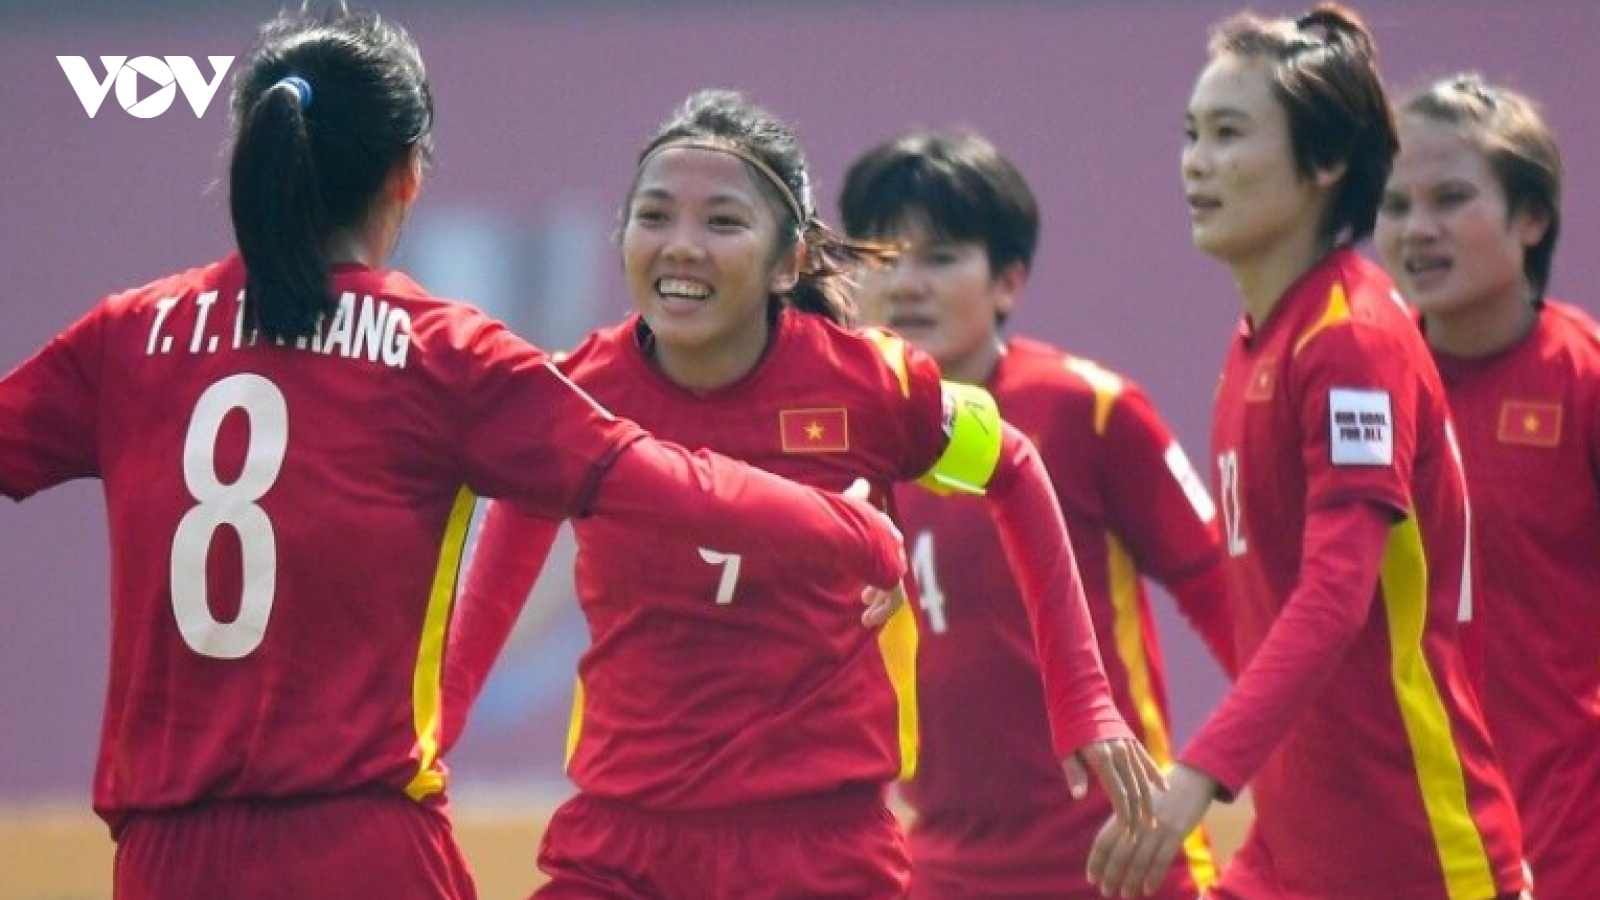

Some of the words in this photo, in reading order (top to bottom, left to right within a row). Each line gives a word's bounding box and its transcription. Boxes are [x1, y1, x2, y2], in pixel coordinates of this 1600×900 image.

[276, 291, 411, 369] ANG
[170, 372, 289, 660] 8
[697, 546, 742, 606] 7
